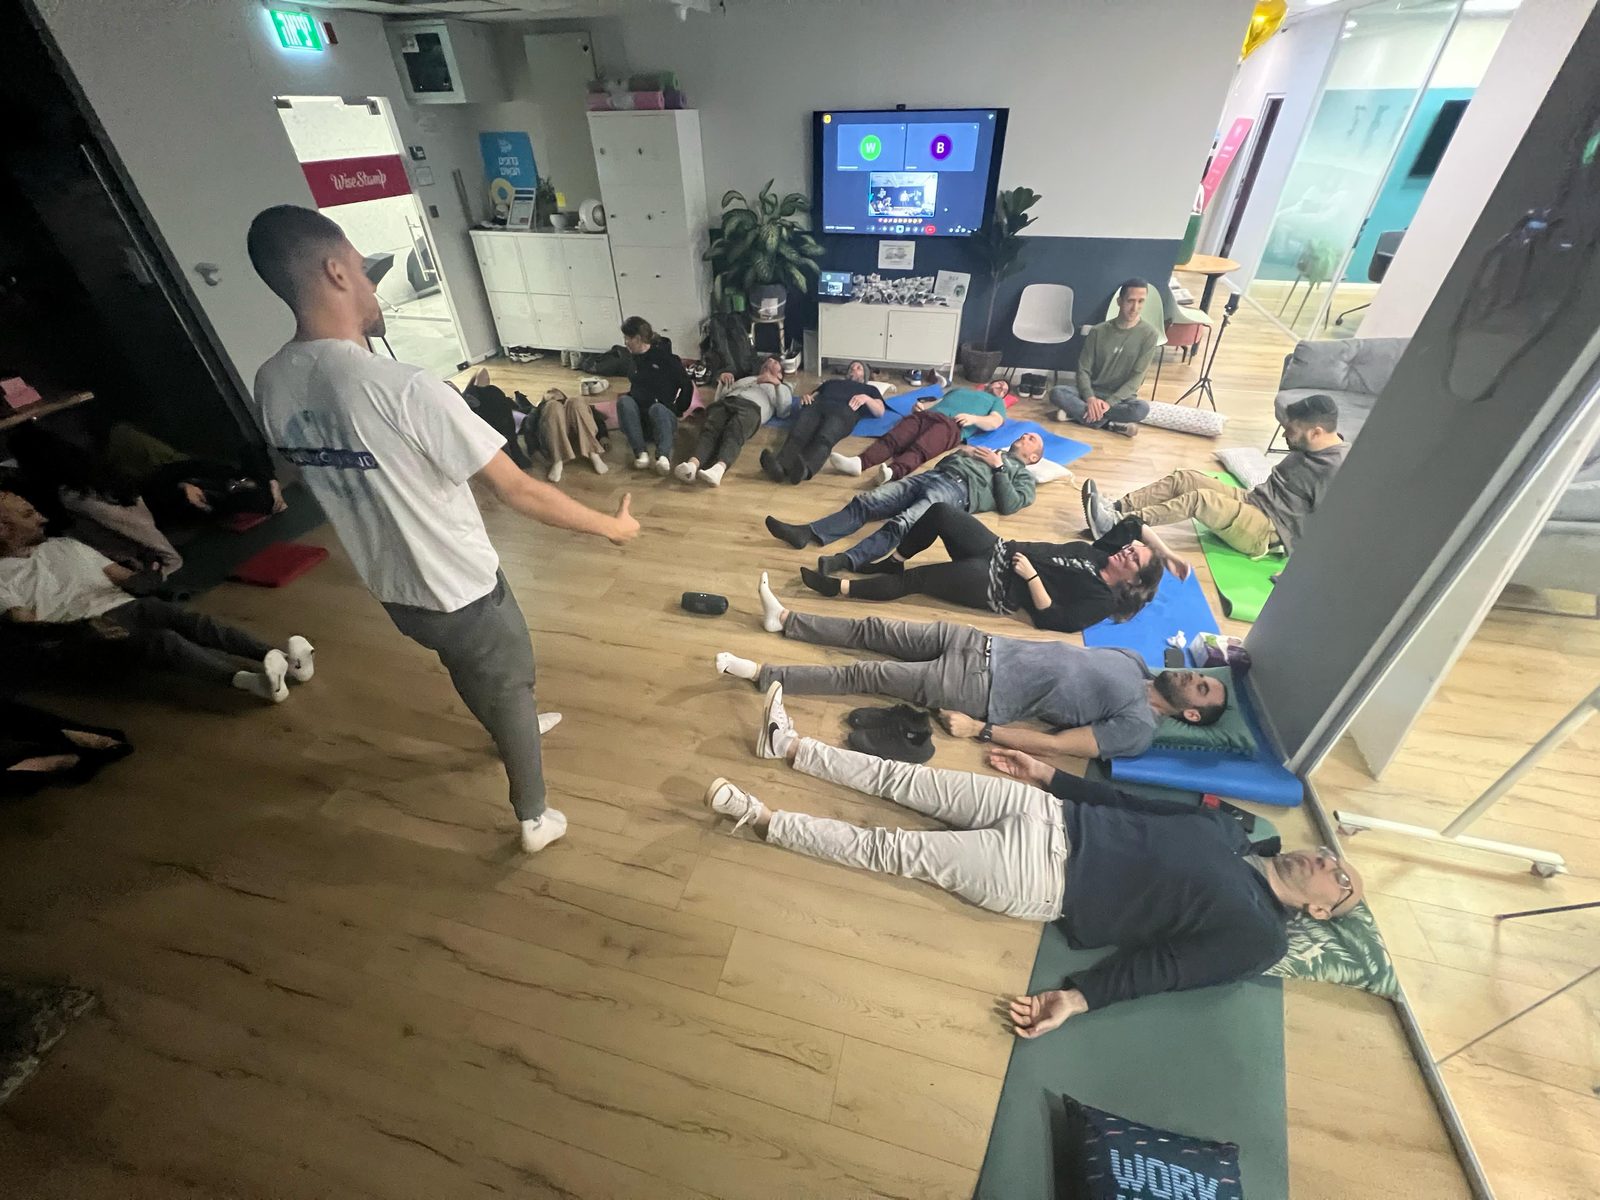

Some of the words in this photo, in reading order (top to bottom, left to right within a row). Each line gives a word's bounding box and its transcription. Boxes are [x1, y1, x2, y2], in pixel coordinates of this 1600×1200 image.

[276, 12, 313, 47] יציאה
[865, 143, 876, 153] W
[936, 142, 945, 153] B
[1110, 1149, 1219, 1200] WORK
